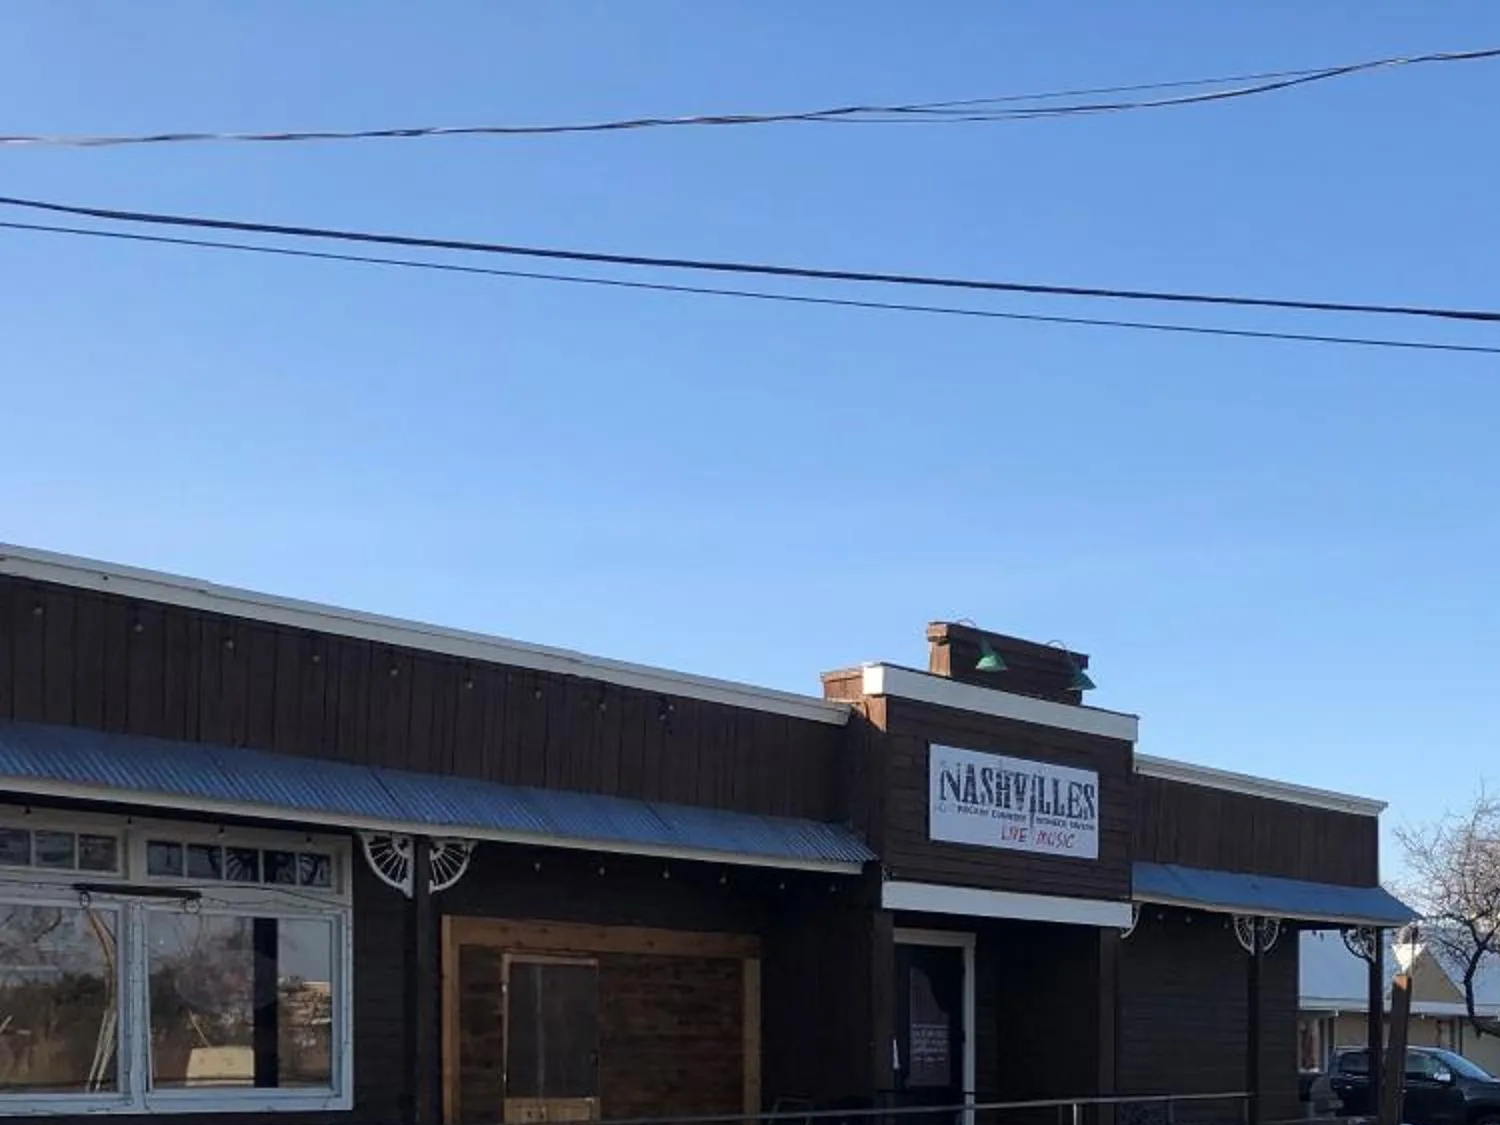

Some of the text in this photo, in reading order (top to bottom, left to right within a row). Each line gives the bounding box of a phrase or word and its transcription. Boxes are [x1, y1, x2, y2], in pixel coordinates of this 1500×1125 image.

[939, 762, 1095, 822] NASHVILLES
[1001, 825, 1076, 849] LIVE MUSIC
